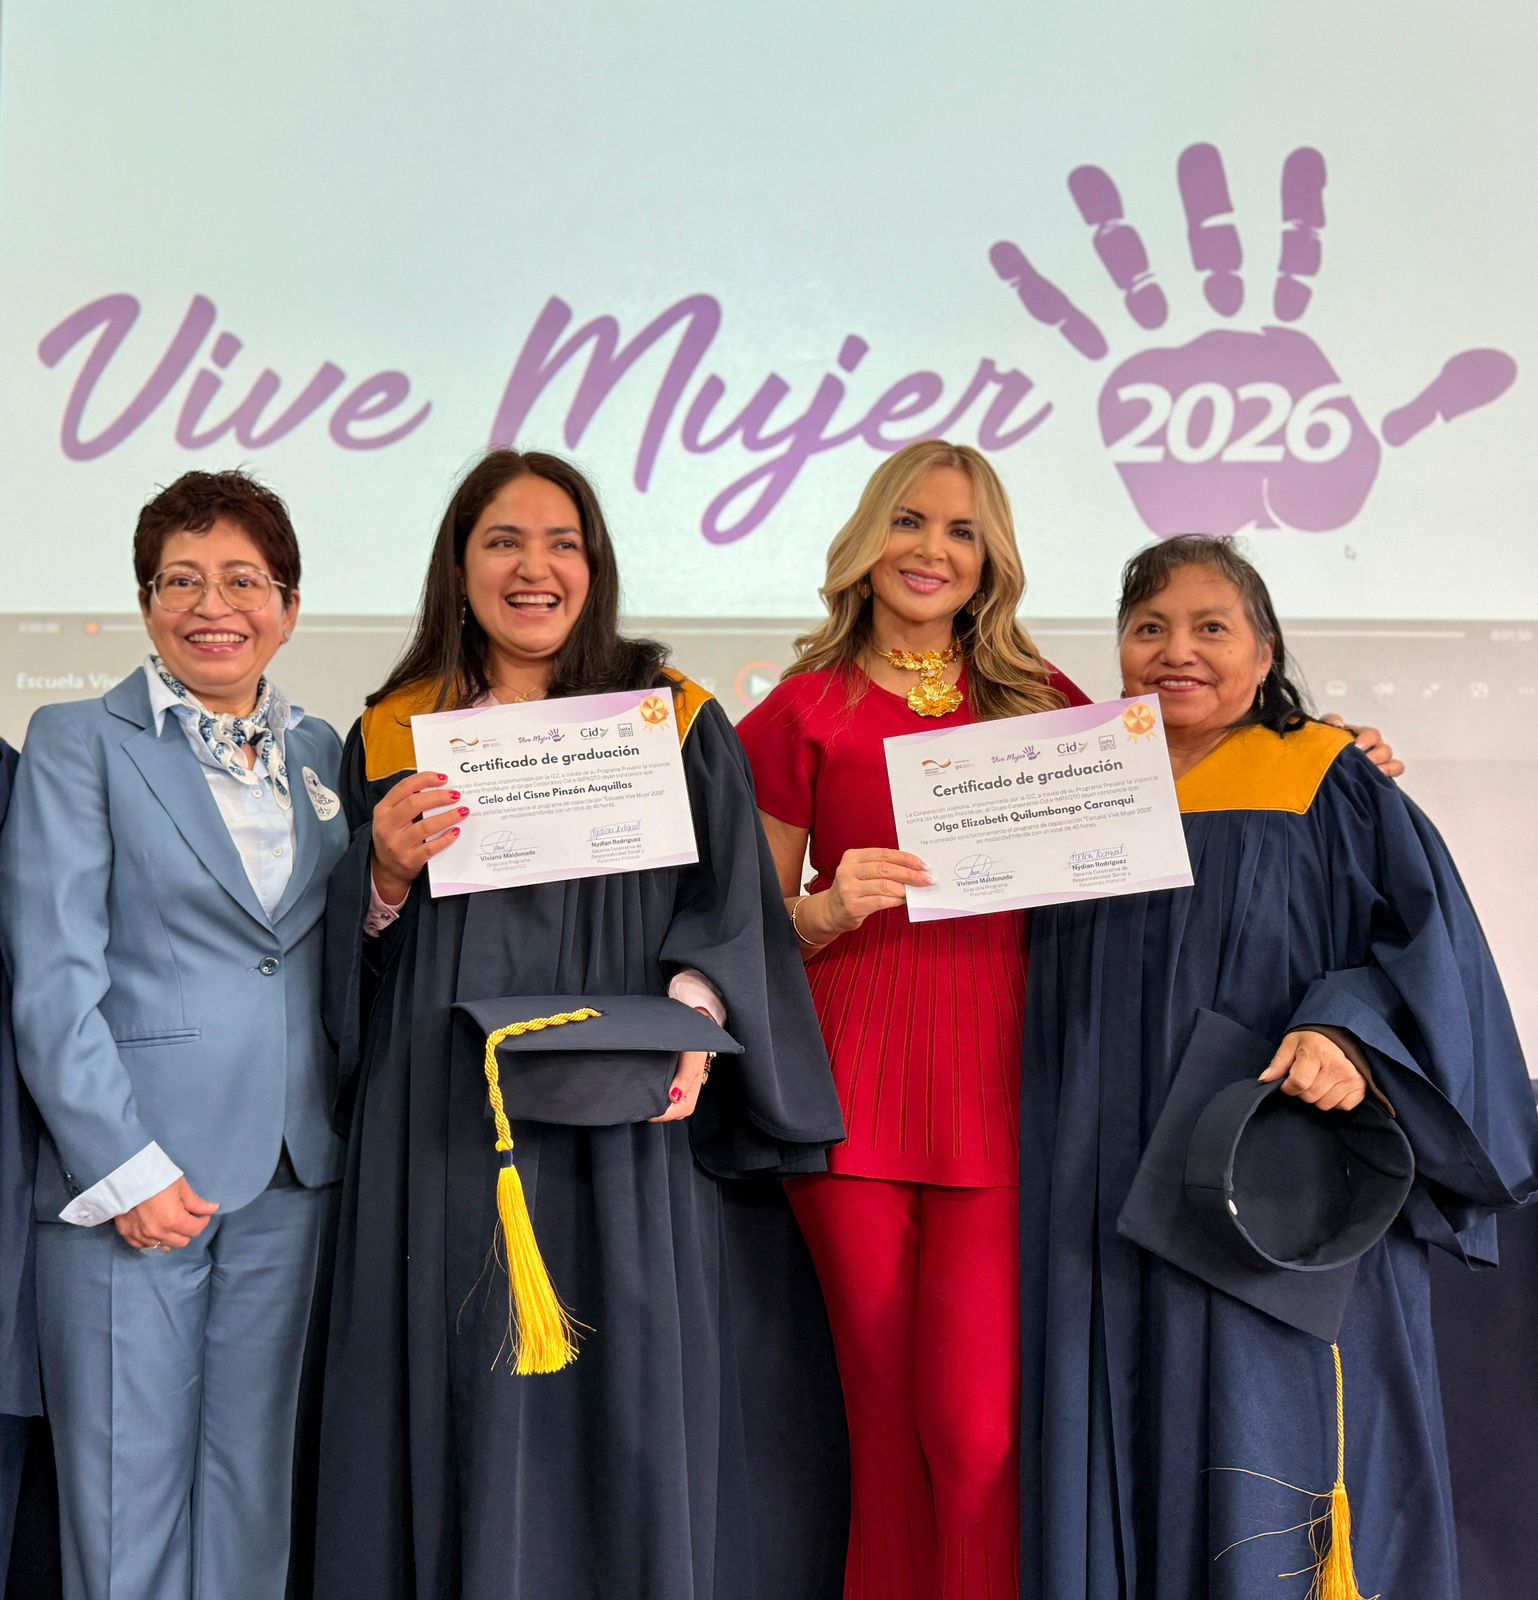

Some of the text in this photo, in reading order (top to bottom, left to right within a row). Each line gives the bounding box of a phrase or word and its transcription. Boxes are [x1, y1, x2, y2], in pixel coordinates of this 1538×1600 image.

[38, 293, 1353, 546] Vive Mujer 2026
[16, 671, 125, 690] Escuela Viv
[580, 727, 599, 738] Cid
[1057, 741, 1077, 754] Cid
[460, 745, 640, 773] Certificado de graduación
[933, 759, 1123, 797] Certificado de graduación
[478, 781, 632, 805] Cielo del Cisne Pinzón Auquillas
[934, 794, 1134, 833] Olga Elizabeth Quilumbango Caranqui
[503, 850, 536, 858] Maldonado
[1072, 863, 1095, 871] Nydian
[956, 874, 1013, 887] Viviana Maldonado
